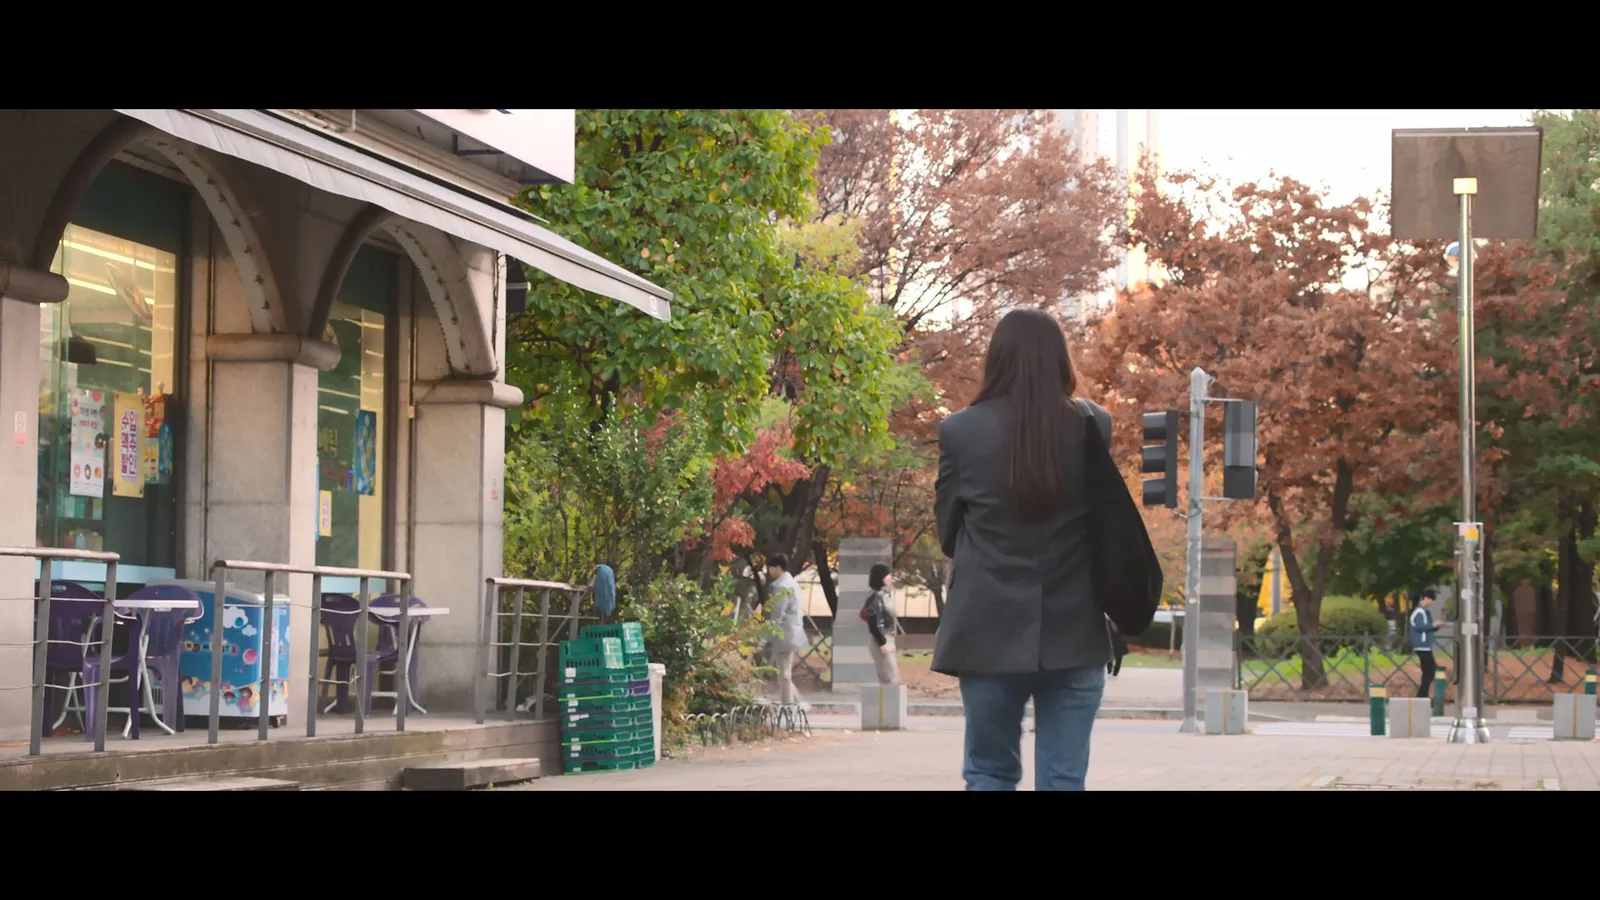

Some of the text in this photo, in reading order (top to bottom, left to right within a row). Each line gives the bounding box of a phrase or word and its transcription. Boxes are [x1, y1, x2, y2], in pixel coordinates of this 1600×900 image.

[121, 410, 137, 432] 수입
[121, 432, 137, 453] 맥주
[121, 453, 137, 475] 할인
